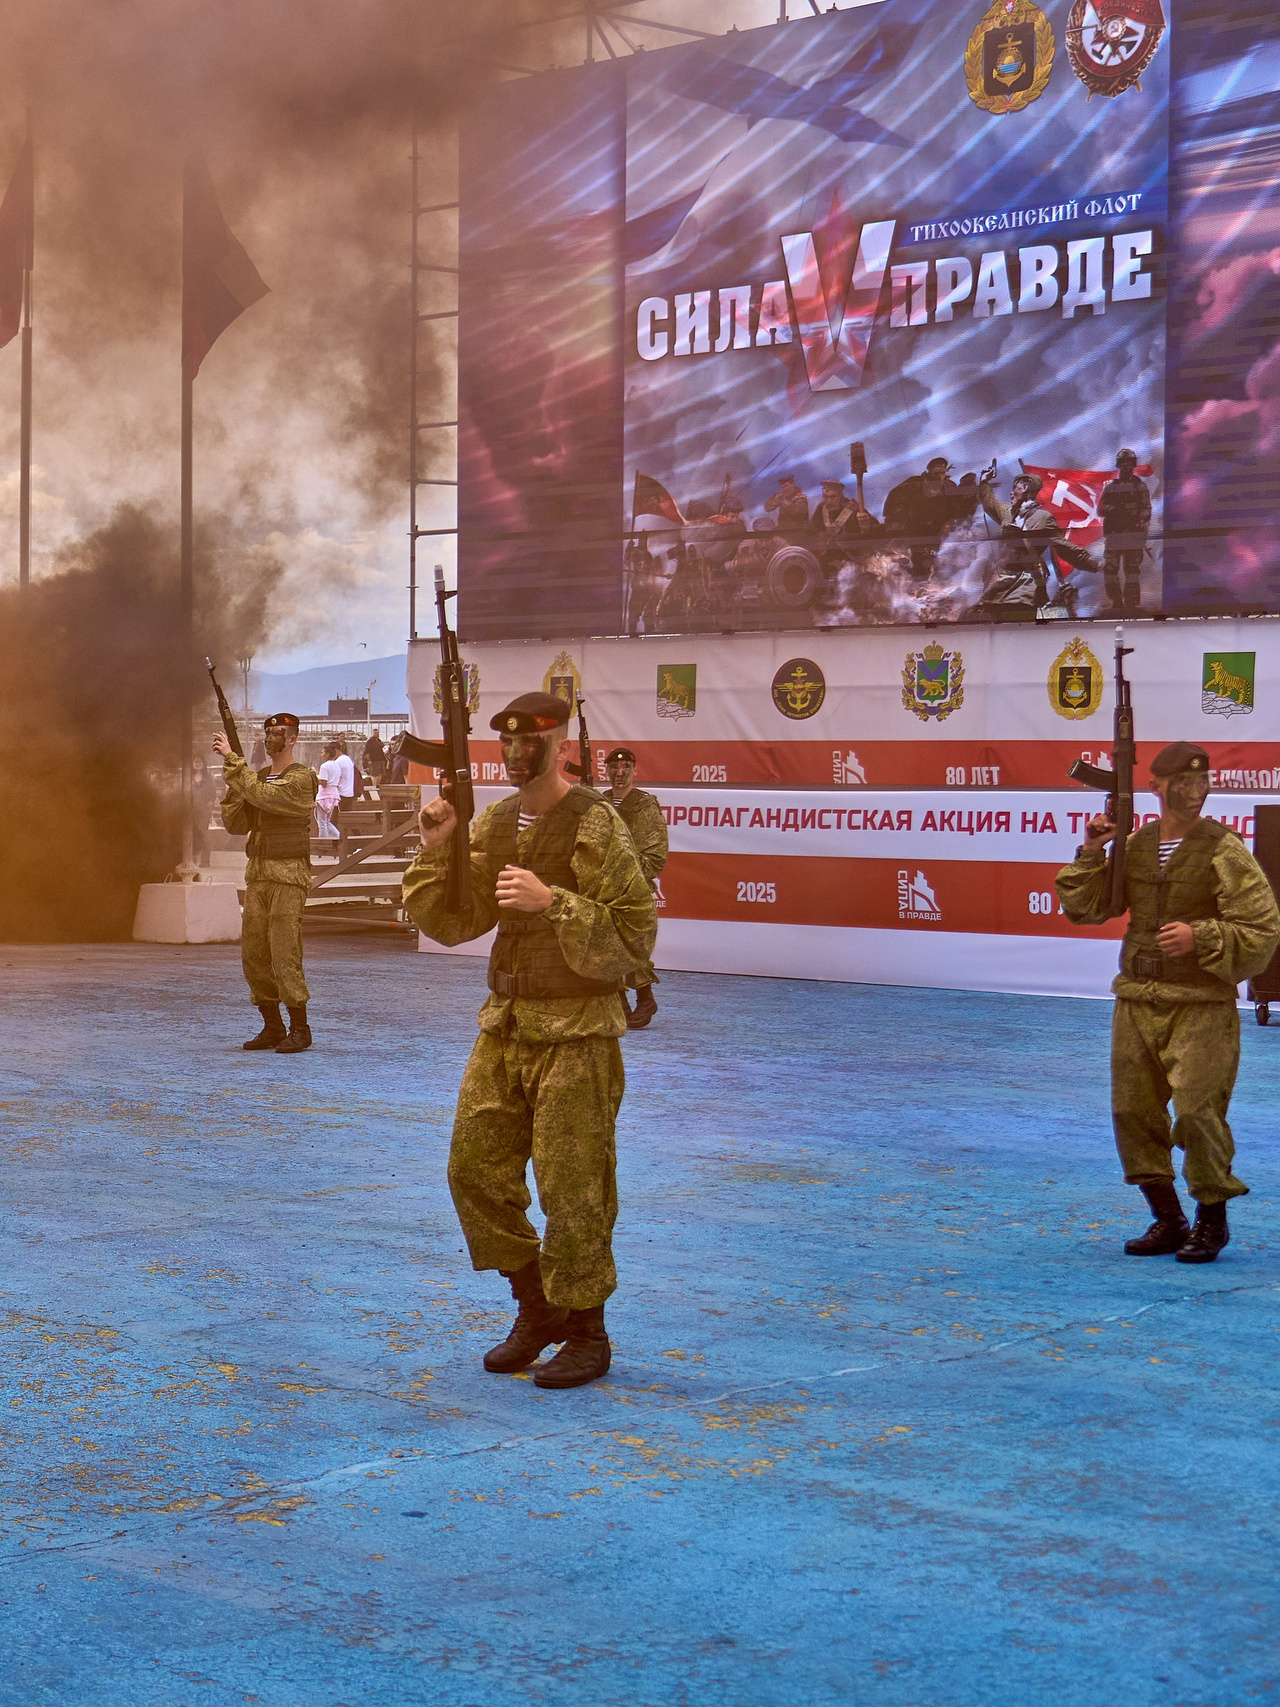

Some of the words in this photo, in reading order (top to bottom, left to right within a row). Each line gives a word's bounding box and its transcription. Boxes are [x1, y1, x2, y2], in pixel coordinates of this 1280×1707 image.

[910, 200, 1079, 242] ТИХООКЕАНСКИЙ
[1084, 194, 1142, 217] ФЛОТ
[636, 280, 793, 361] СИЛА
[780, 220, 896, 392] V
[888, 230, 1154, 328] ПРАВДЕ
[482, 762, 511, 780] ПРА
[692, 765, 727, 783] 2025
[945, 766, 965, 786] 80
[970, 766, 1000, 786] ЛЕТ
[1207, 767, 1280, 789] ЕЛИКОЙ
[920, 810, 1011, 835] АКЦИЯ
[1020, 812, 1057, 834] НА
[736, 881, 776, 903] 2025
[897, 869, 908, 911] СИЛА
[1028, 892, 1052, 914] 80
[898, 911, 905, 919] В
[907, 911, 942, 921] ПРАВДЕ
